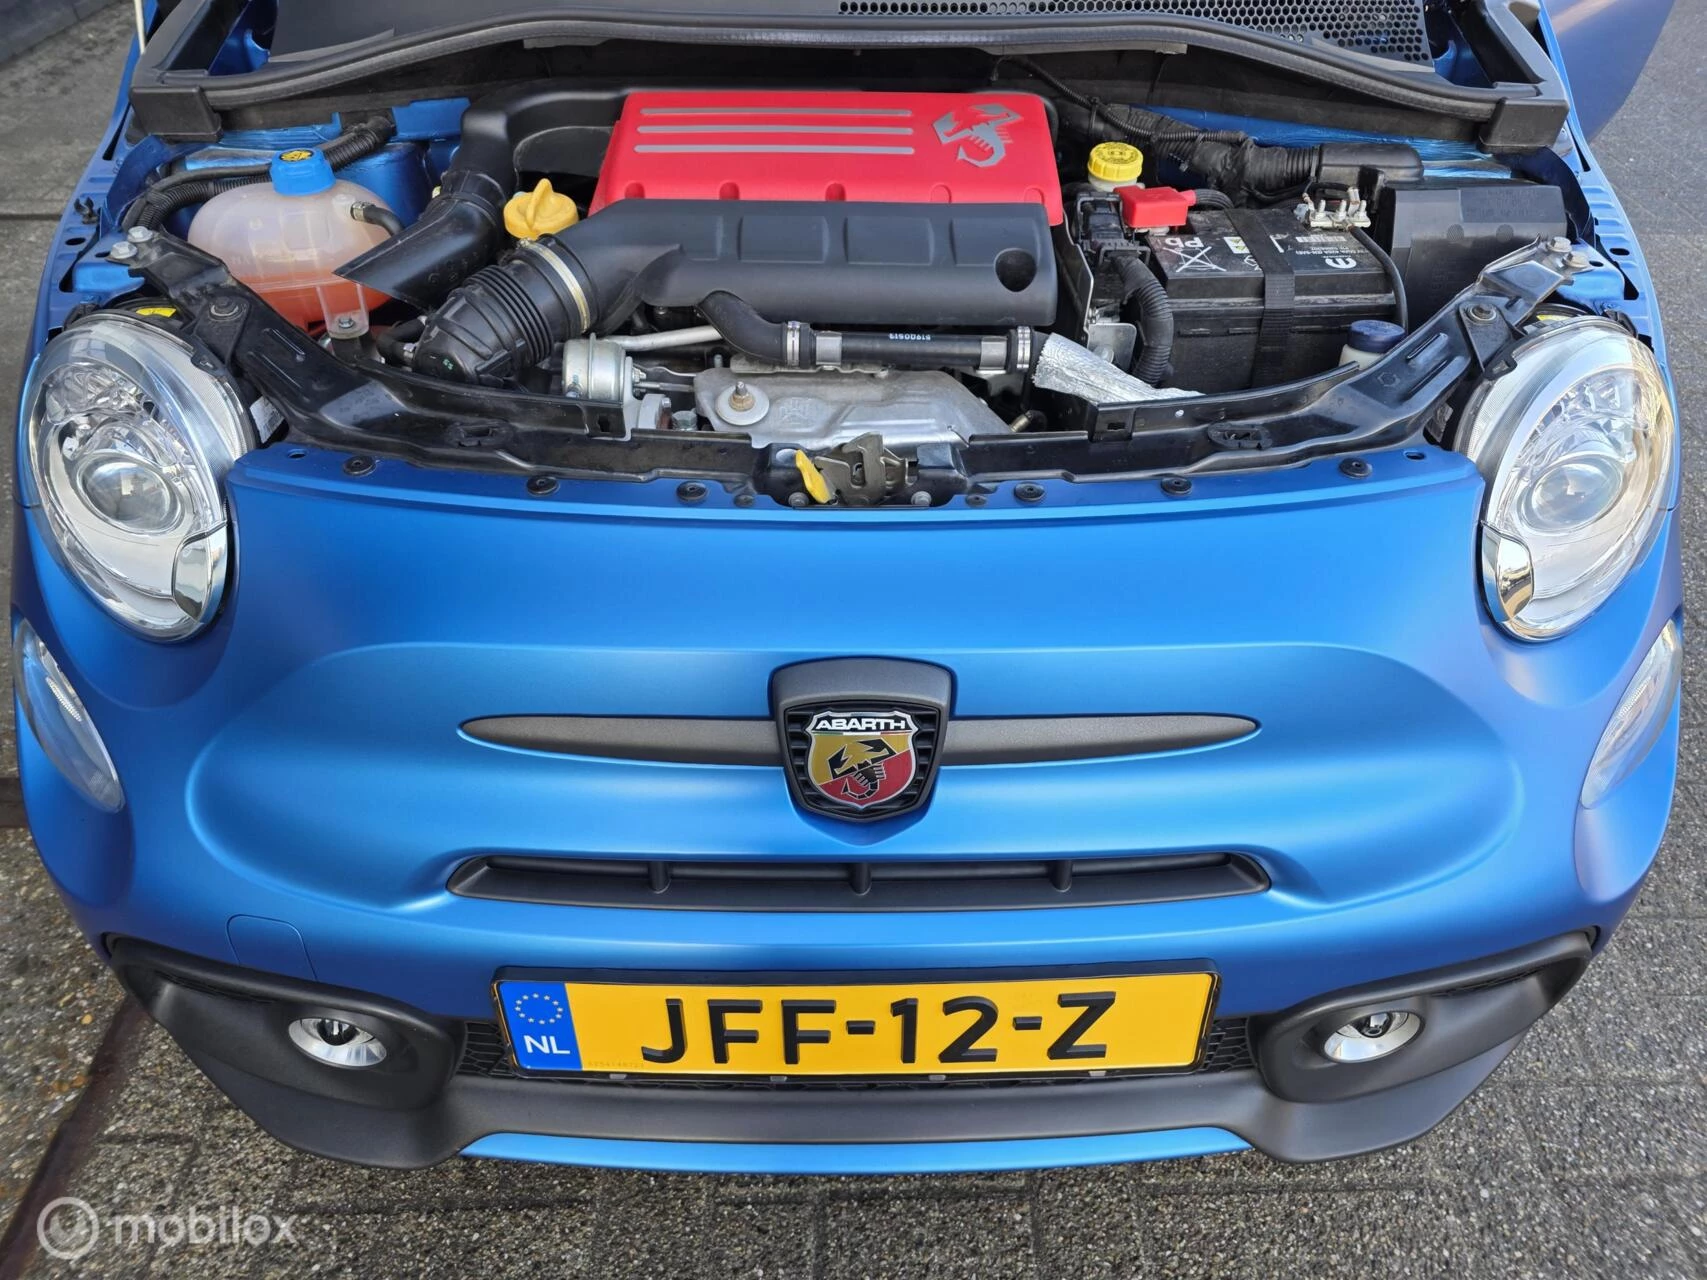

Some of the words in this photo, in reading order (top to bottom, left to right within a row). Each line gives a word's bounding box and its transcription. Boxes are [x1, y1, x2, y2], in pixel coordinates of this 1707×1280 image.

[1165, 237, 1204, 248] Pb
[815, 718, 905, 730] ABARTH
[641, 991, 1116, 1065] JFF-12-Z
[523, 1035, 570, 1054] NL
